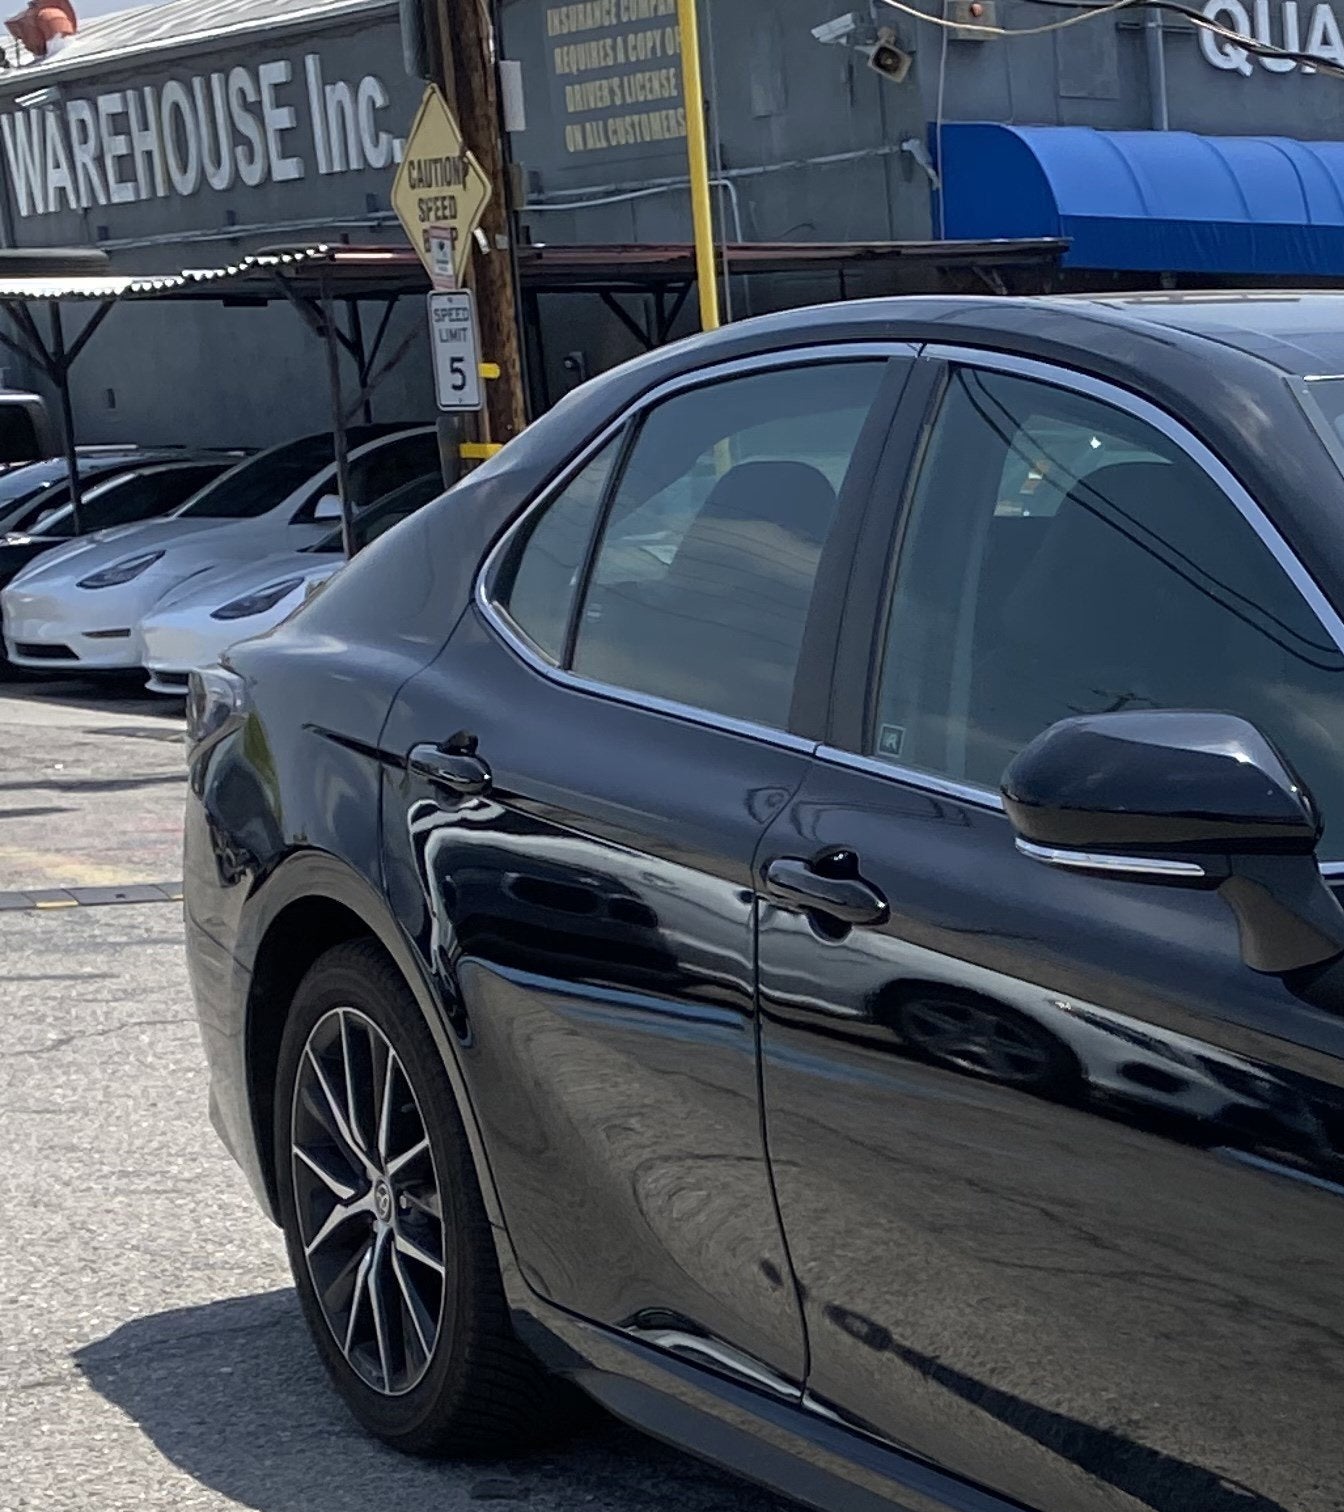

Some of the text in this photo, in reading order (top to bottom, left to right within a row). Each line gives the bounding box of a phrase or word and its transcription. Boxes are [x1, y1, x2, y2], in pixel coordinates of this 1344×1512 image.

[620, 0, 677, 22] COMPAN
[554, 38, 614, 75] REQUIRES
[616, 35, 625, 64] A
[627, 28, 662, 62] COPY
[565, 68, 678, 113] DRIVER'S LICENSE
[1, 53, 406, 218] WAREHOUSE Inc.
[565, 107, 687, 153] ON ALL CUSTOMERS
[407, 156, 463, 190] CAUTION
[418, 194, 457, 223] SPEED
[433, 306, 470, 323] SPEED
[439, 327, 468, 344] LIMIT
[448, 355, 467, 391] 5
